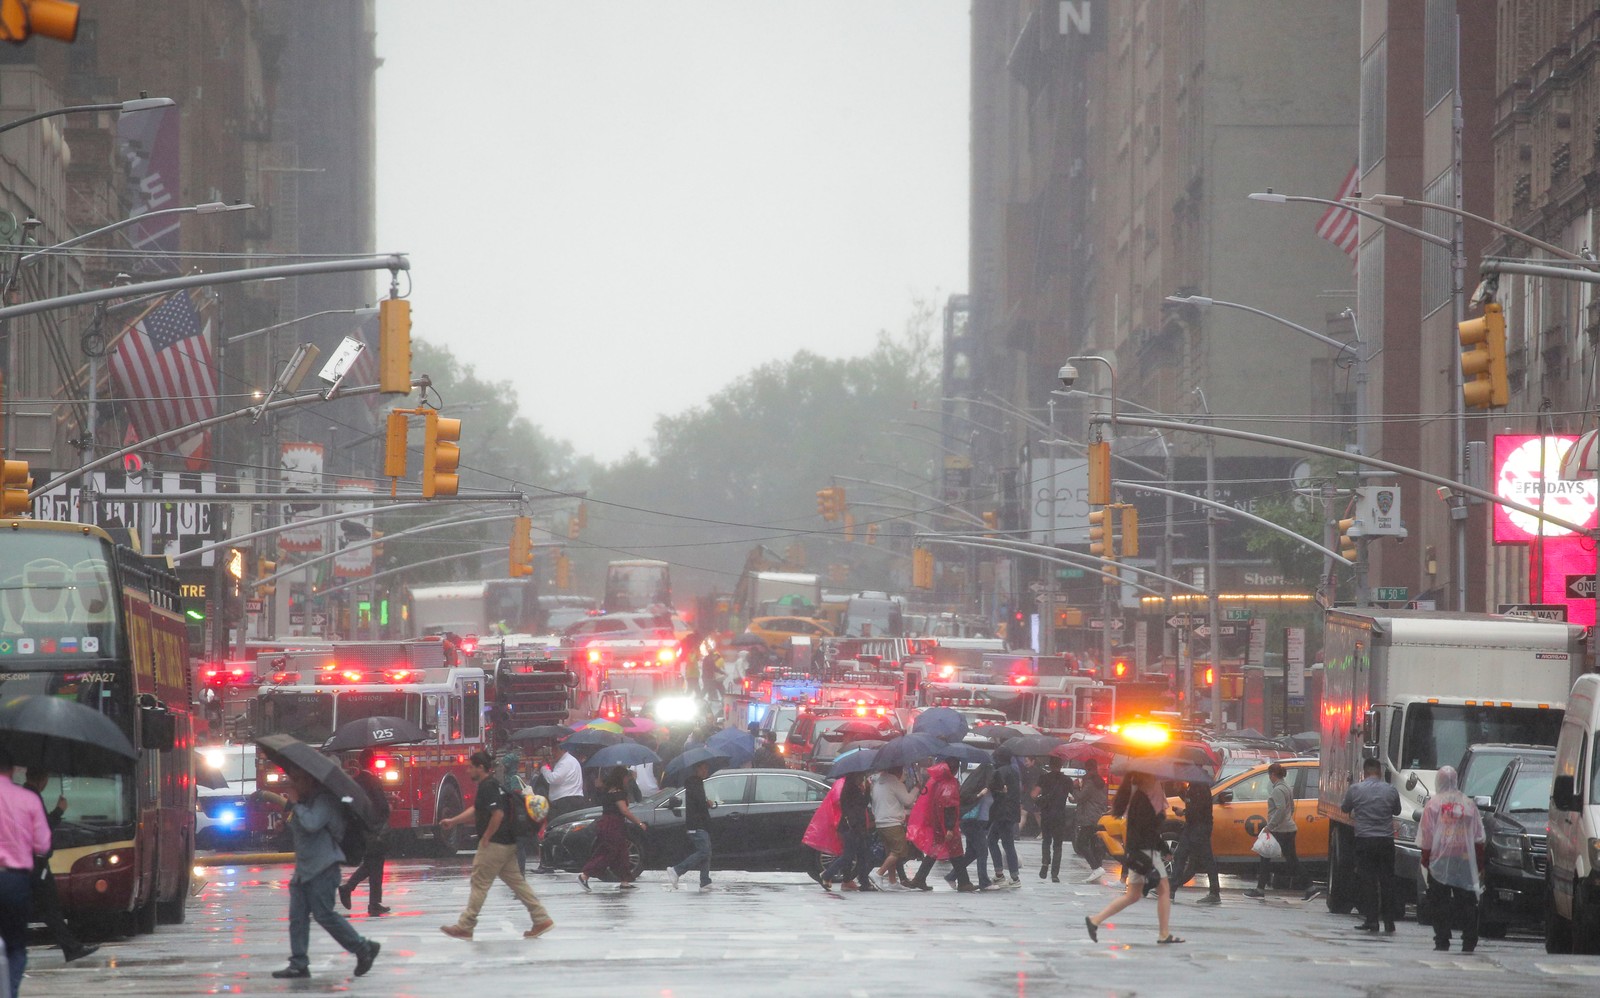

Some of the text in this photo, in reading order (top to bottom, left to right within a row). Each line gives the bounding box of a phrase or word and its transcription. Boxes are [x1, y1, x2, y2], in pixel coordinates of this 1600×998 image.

[1524, 482, 1584, 493] FRDAYS
[180, 585, 206, 597] TRE
[1380, 590, 1387, 599] W
[1389, 590, 1398, 599] 50
[1538, 611, 1558, 619] WAY
[81, 673, 115, 682] AYA27
